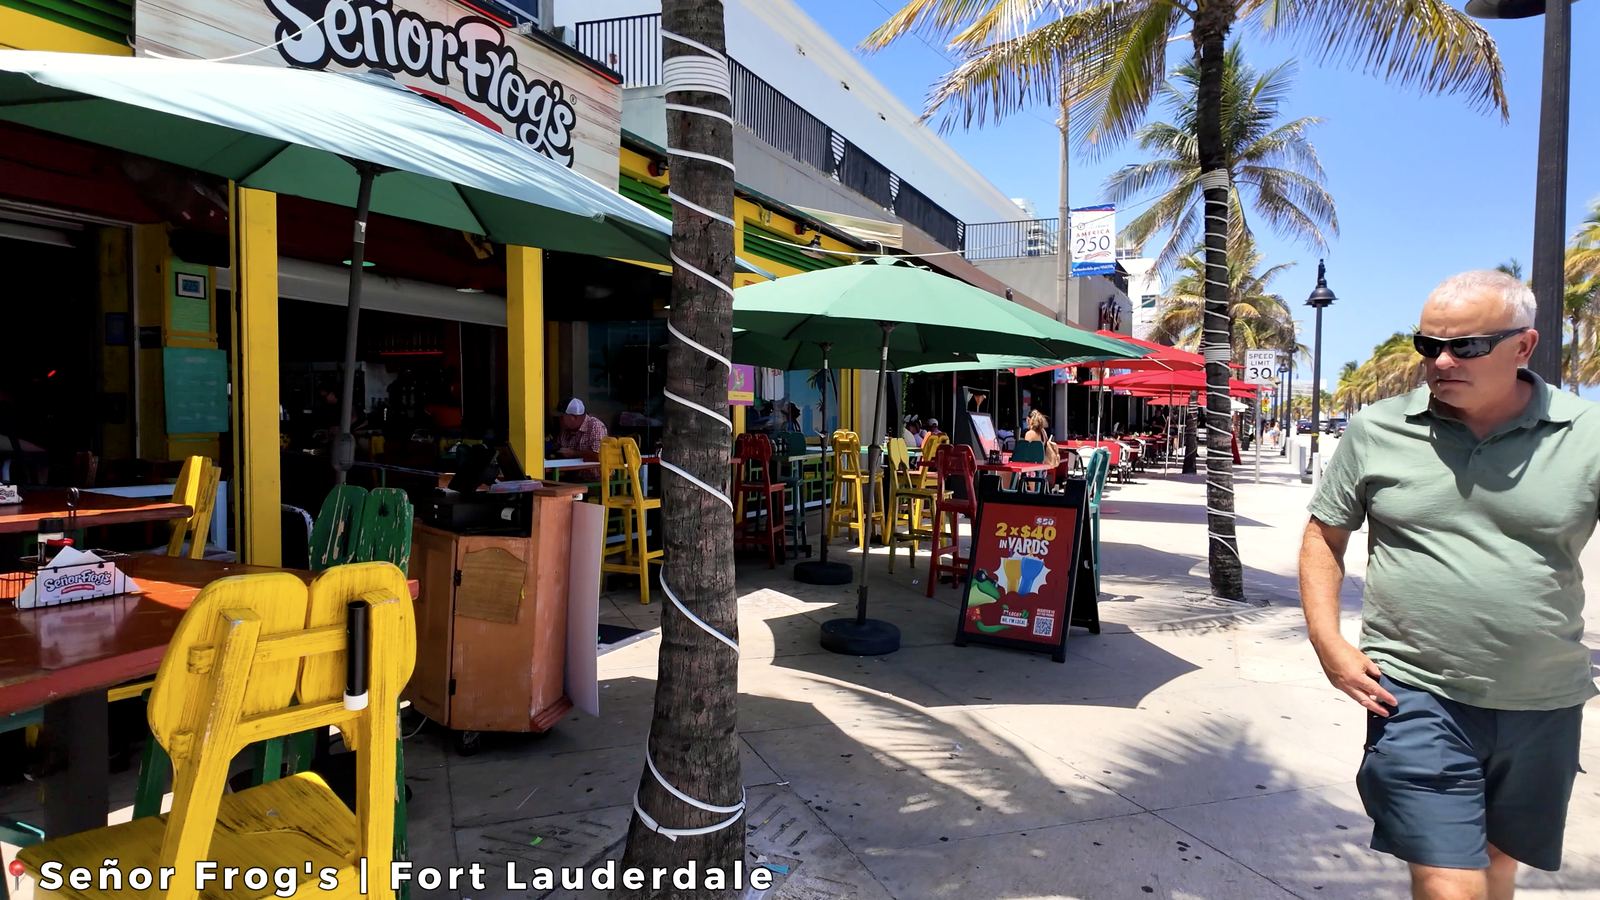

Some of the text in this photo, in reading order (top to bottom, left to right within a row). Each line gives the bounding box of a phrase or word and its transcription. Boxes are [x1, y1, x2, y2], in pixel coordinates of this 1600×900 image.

[272, 0, 577, 168] Señor Frog's
[1076, 228, 1110, 237] AMERICA
[1076, 235, 1110, 254] 250
[1250, 368, 1272, 379] 30
[995, 522, 1008, 537] 2
[1020, 525, 1057, 541] $40
[999, 537, 1050, 555] IN YARDS
[44, 574, 82, 592] Señor
[80, 569, 112, 585] Frog's
